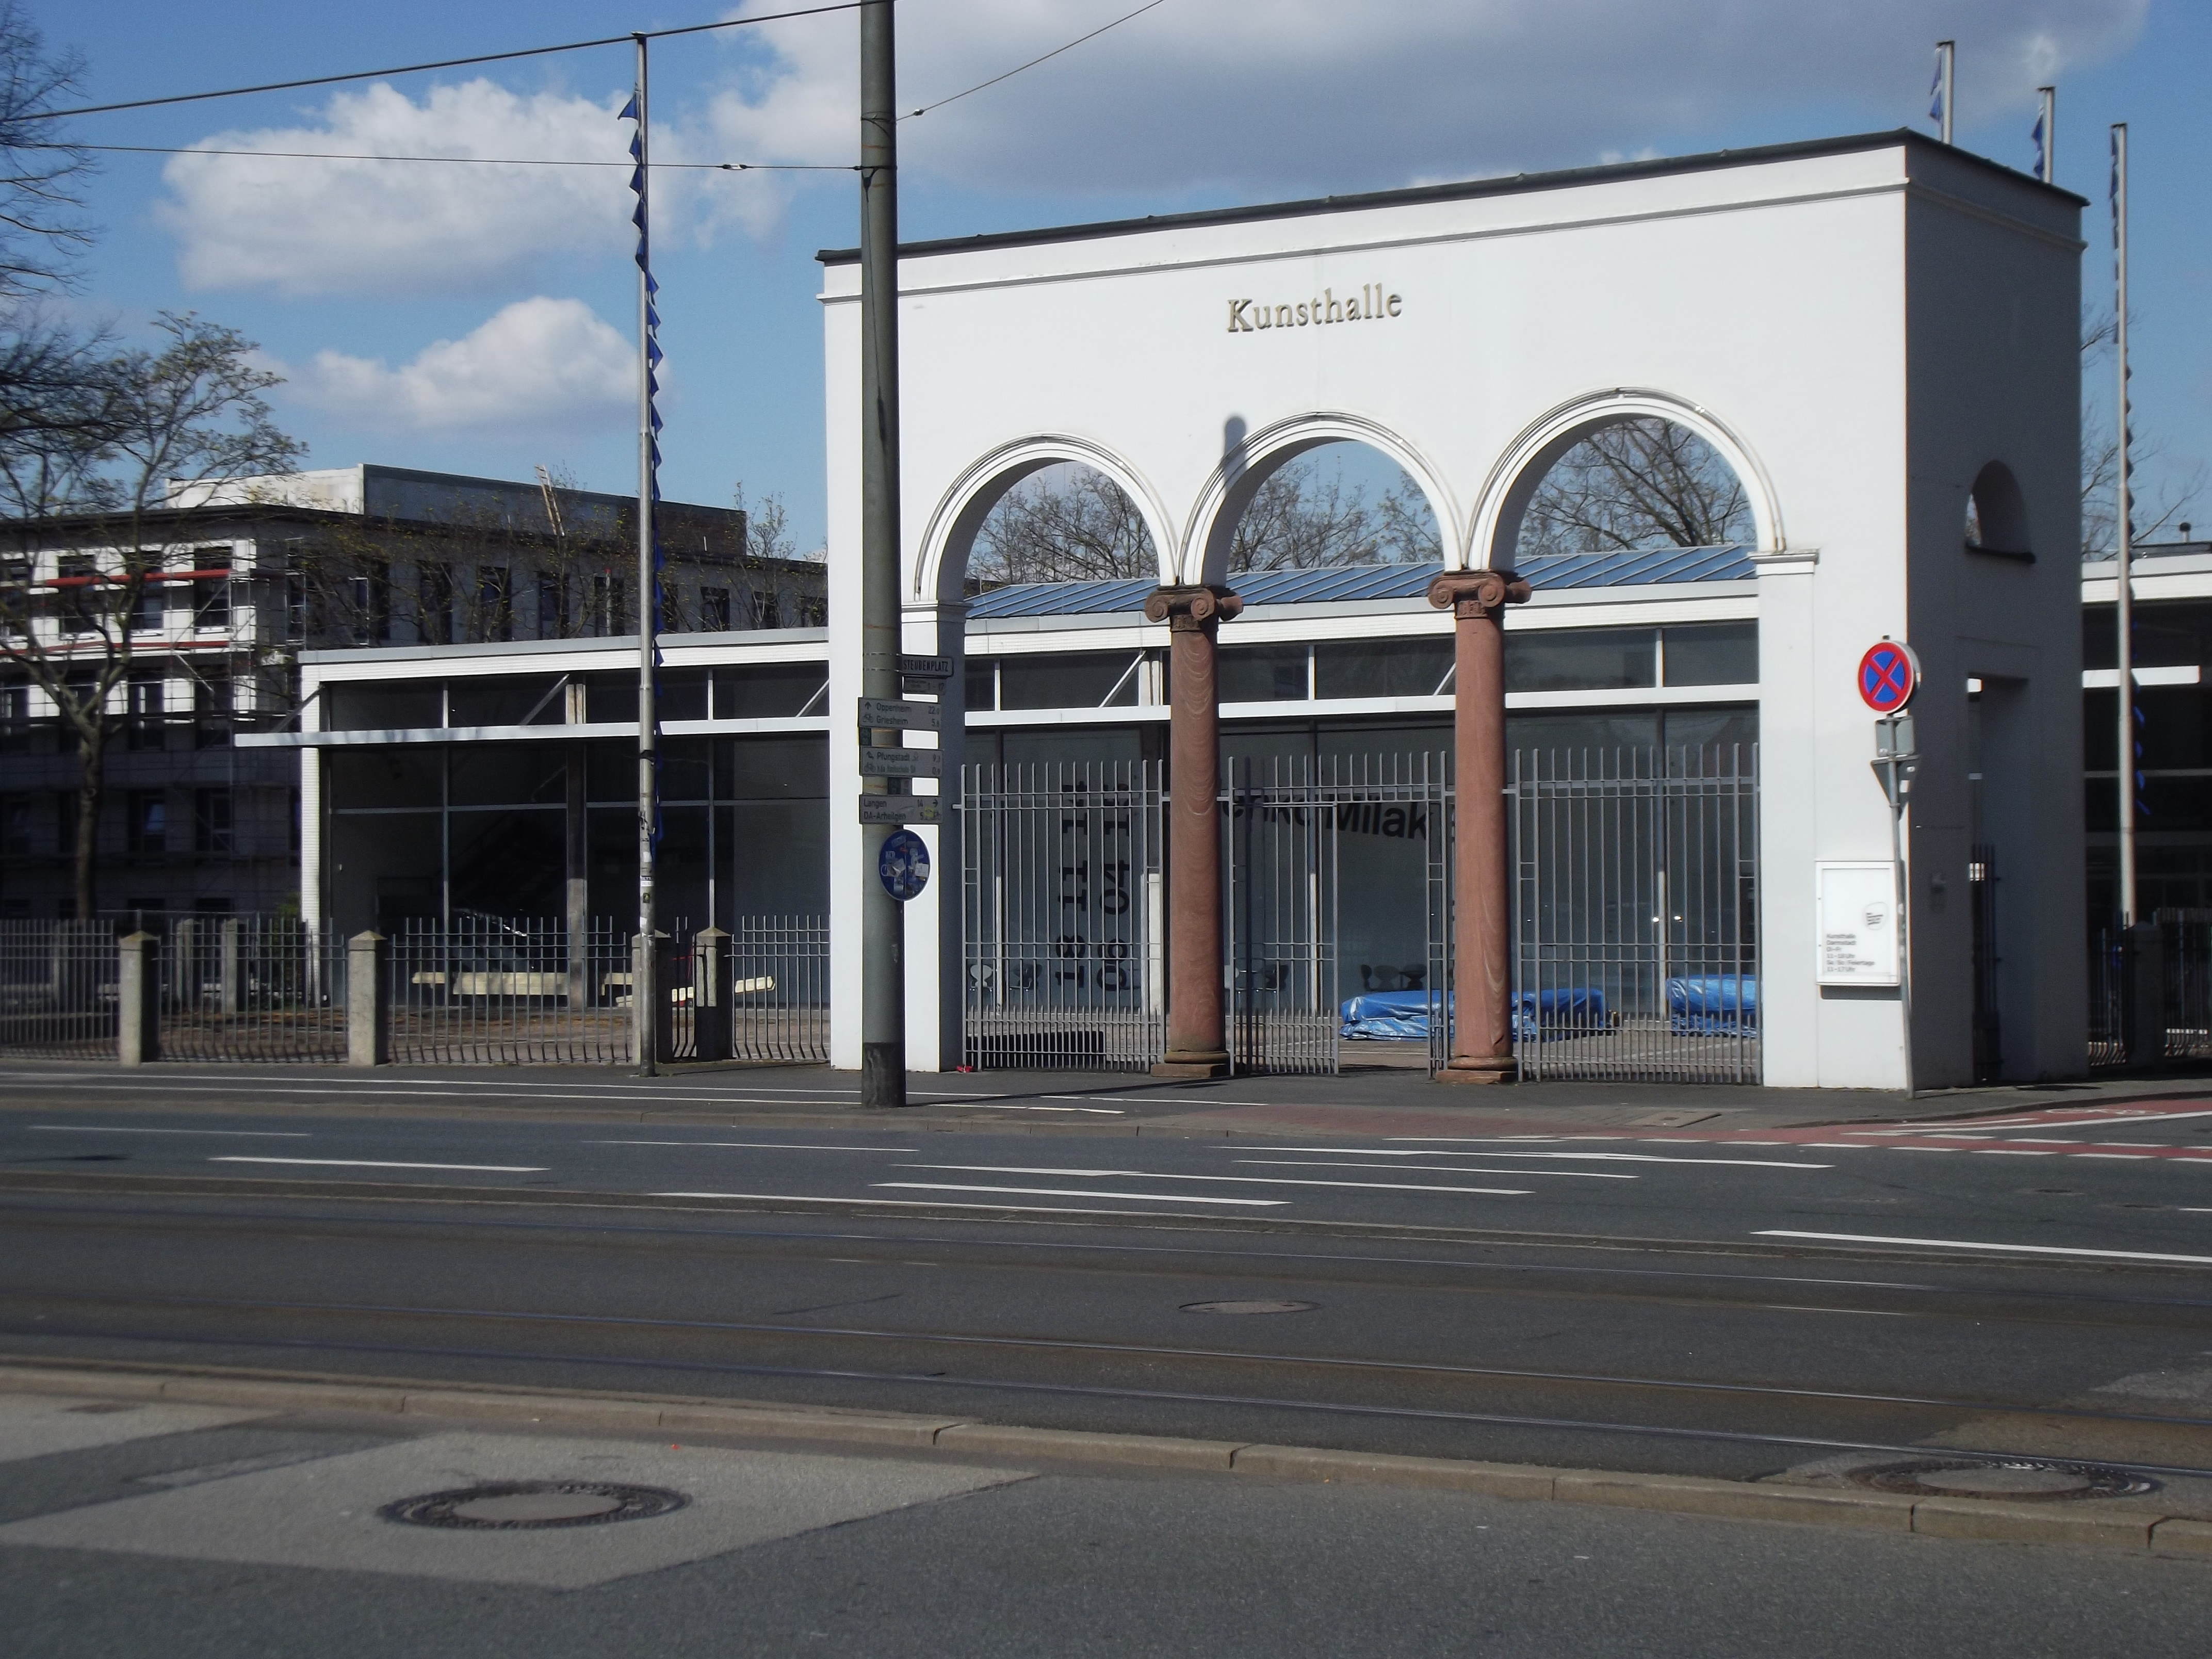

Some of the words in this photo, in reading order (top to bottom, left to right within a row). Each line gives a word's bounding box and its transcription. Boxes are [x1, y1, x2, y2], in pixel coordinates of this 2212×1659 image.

[1227, 282, 1402, 333] Kunsthalle
[904, 659, 948, 672] STEUBENPLATZ
[876, 703, 912, 713] Oppenheim
[876, 715, 908, 725] Griesheim
[877, 752, 910, 762] Pfungstadt
[864, 799, 887, 809] Langen
[864, 811, 906, 822] DA-Arheilgen
[1326, 793, 1435, 841] Milak
